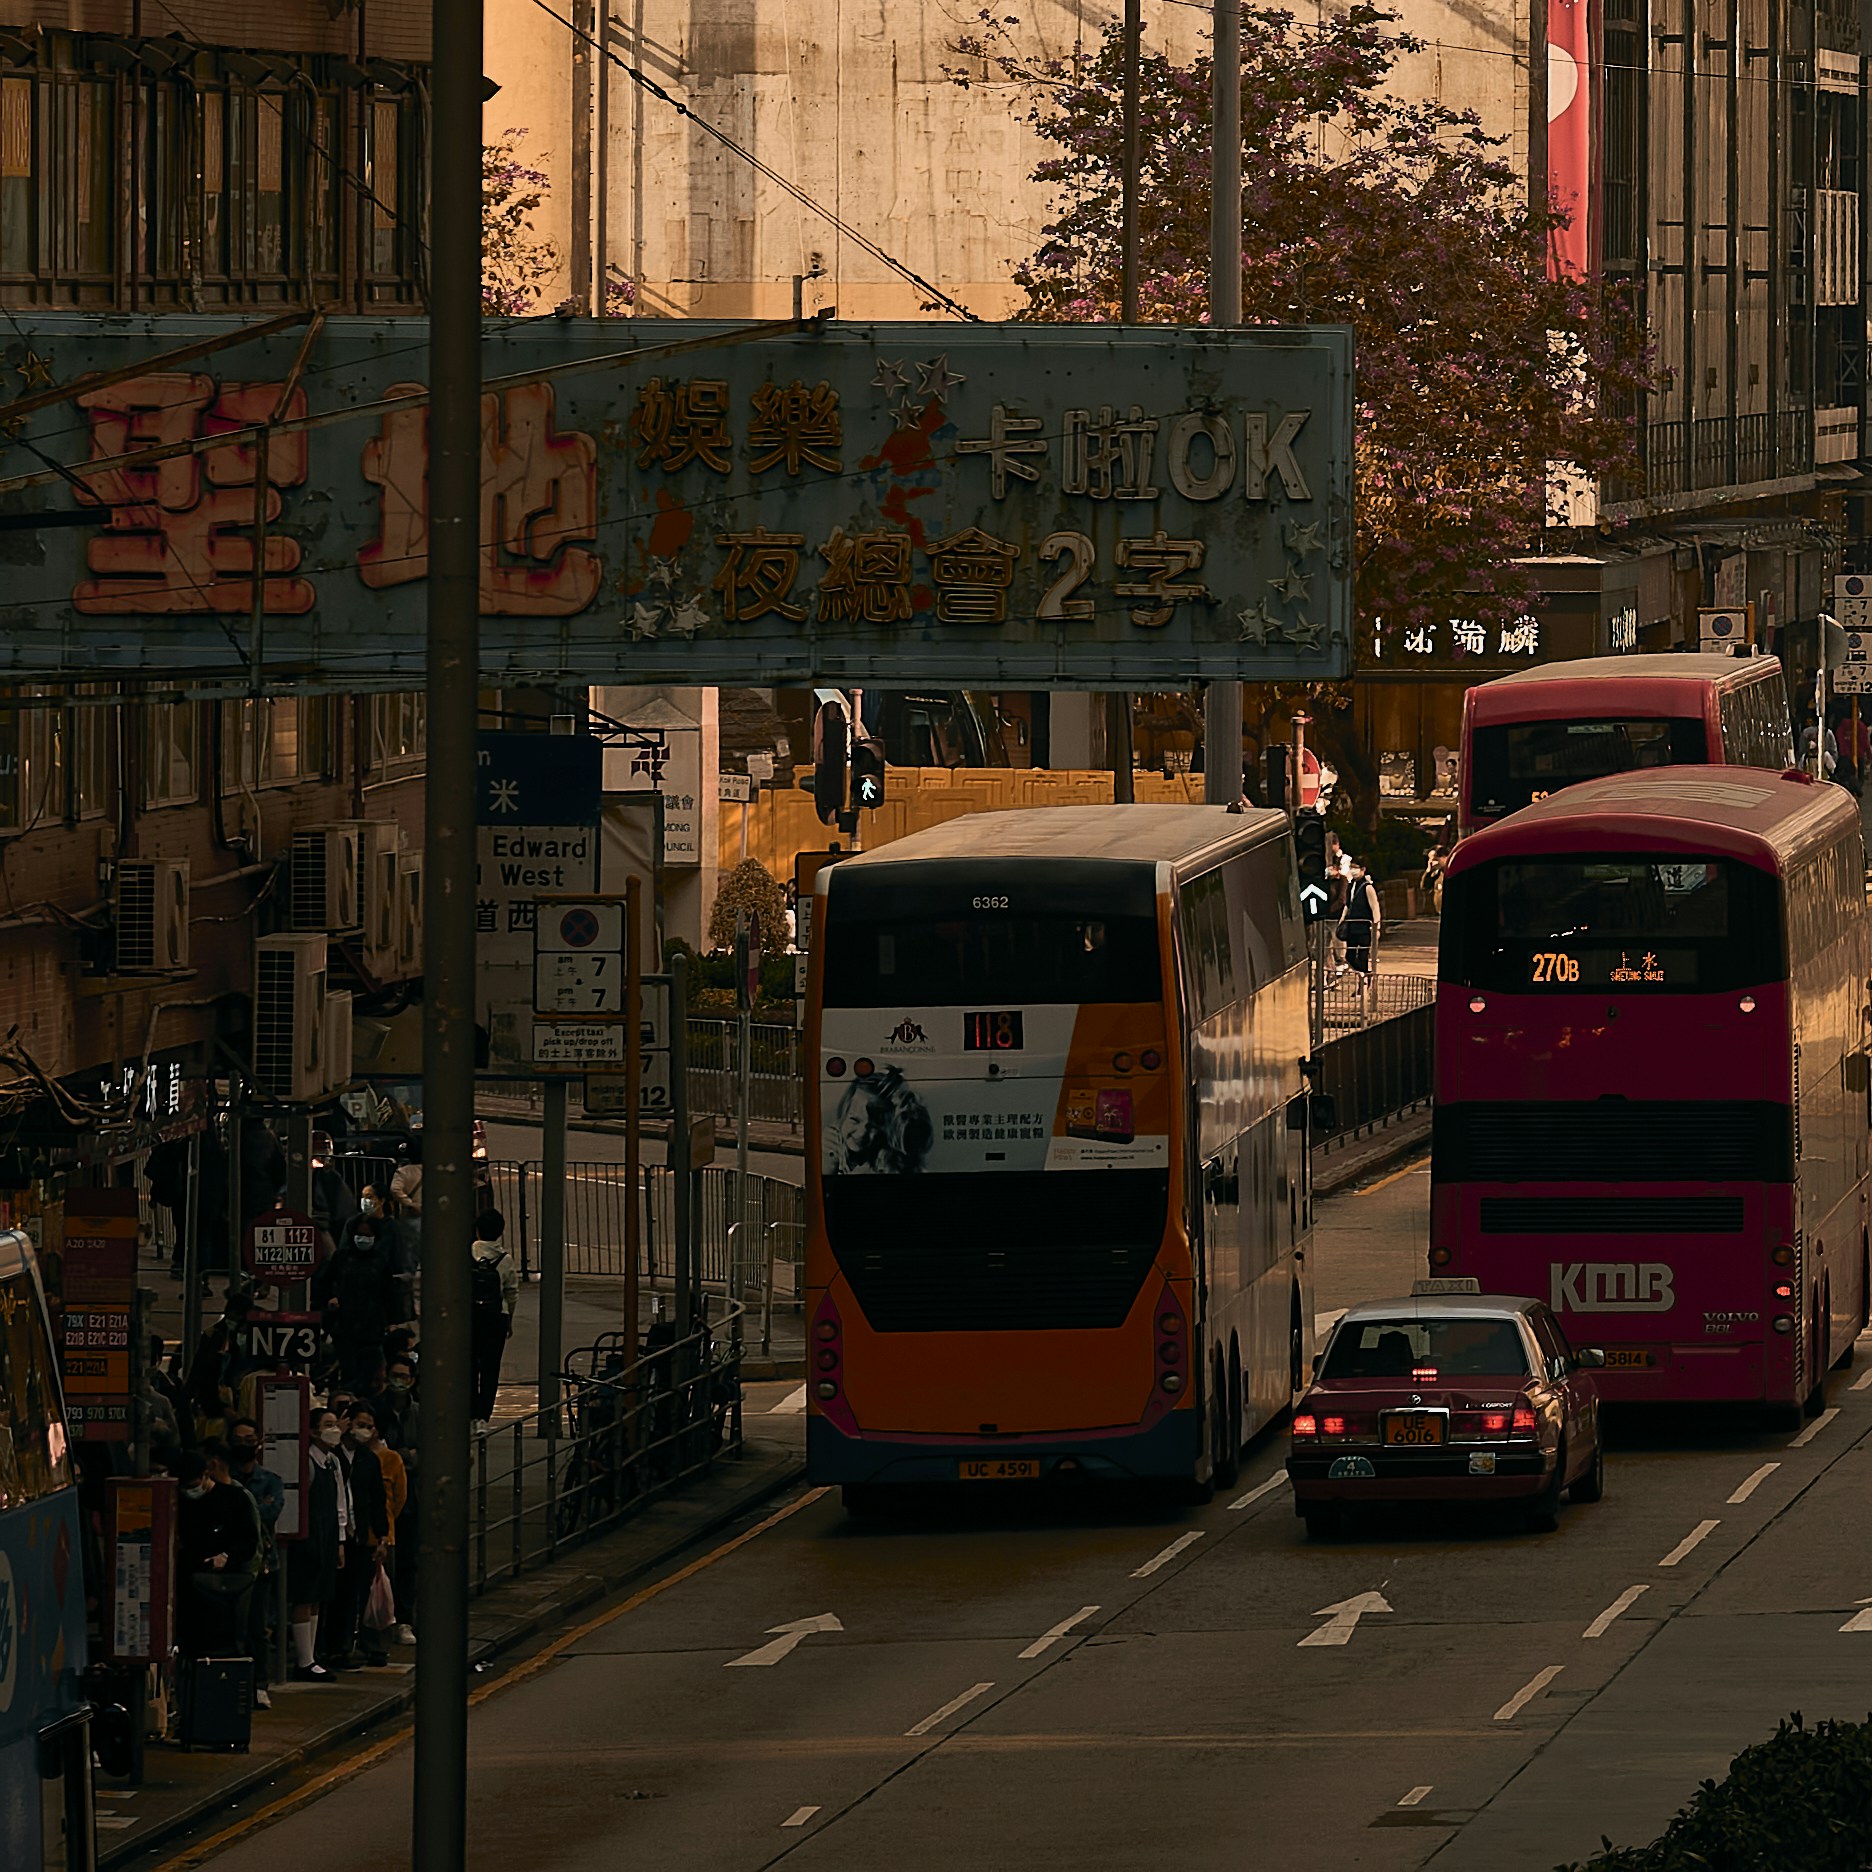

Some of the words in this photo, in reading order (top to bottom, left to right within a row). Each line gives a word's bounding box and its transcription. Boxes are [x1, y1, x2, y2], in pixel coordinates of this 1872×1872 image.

[638, 376, 844, 476] 娛樂
[955, 402, 1312, 502] 卡啦OK
[713, 526, 1210, 626] 夜總會2字
[1859, 681, 1872, 693] 12
[488, 779, 520, 814] 米
[493, 835, 586, 859] Edward
[500, 864, 564, 887] West
[972, 895, 1009, 910] 6362
[592, 957, 606, 977] 7
[1532, 952, 1580, 983] 270B
[1612, 951, 1658, 973] 上水
[557, 988, 574, 996] pm
[592, 989, 606, 1008] 7
[554, 1028, 585, 1038] Except
[975, 1011, 1013, 1049] 118
[543, 1037, 562, 1046] pick
[641, 1086, 666, 1106] 12
[261, 1229, 275, 1244] 81
[287, 1229, 310, 1244] 112
[256, 1247, 283, 1262] N122
[285, 1248, 313, 1263] N171
[1418, 1279, 1474, 1292] TAXI
[1550, 1263, 1676, 1313] KMB
[66, 1315, 85, 1328] 79X
[88, 1315, 107, 1328] E21
[1703, 1312, 1760, 1323] VOLVO
[252, 1326, 316, 1358] N73
[1605, 1350, 1642, 1367] 5814
[66, 1407, 83, 1420] 793
[1403, 1416, 1426, 1429] UE
[1392, 1429, 1435, 1444] 6016
[966, 1462, 994, 1477] UC
[998, 1462, 1034, 1477] 4591
[1346, 1462, 1356, 1472] 4
